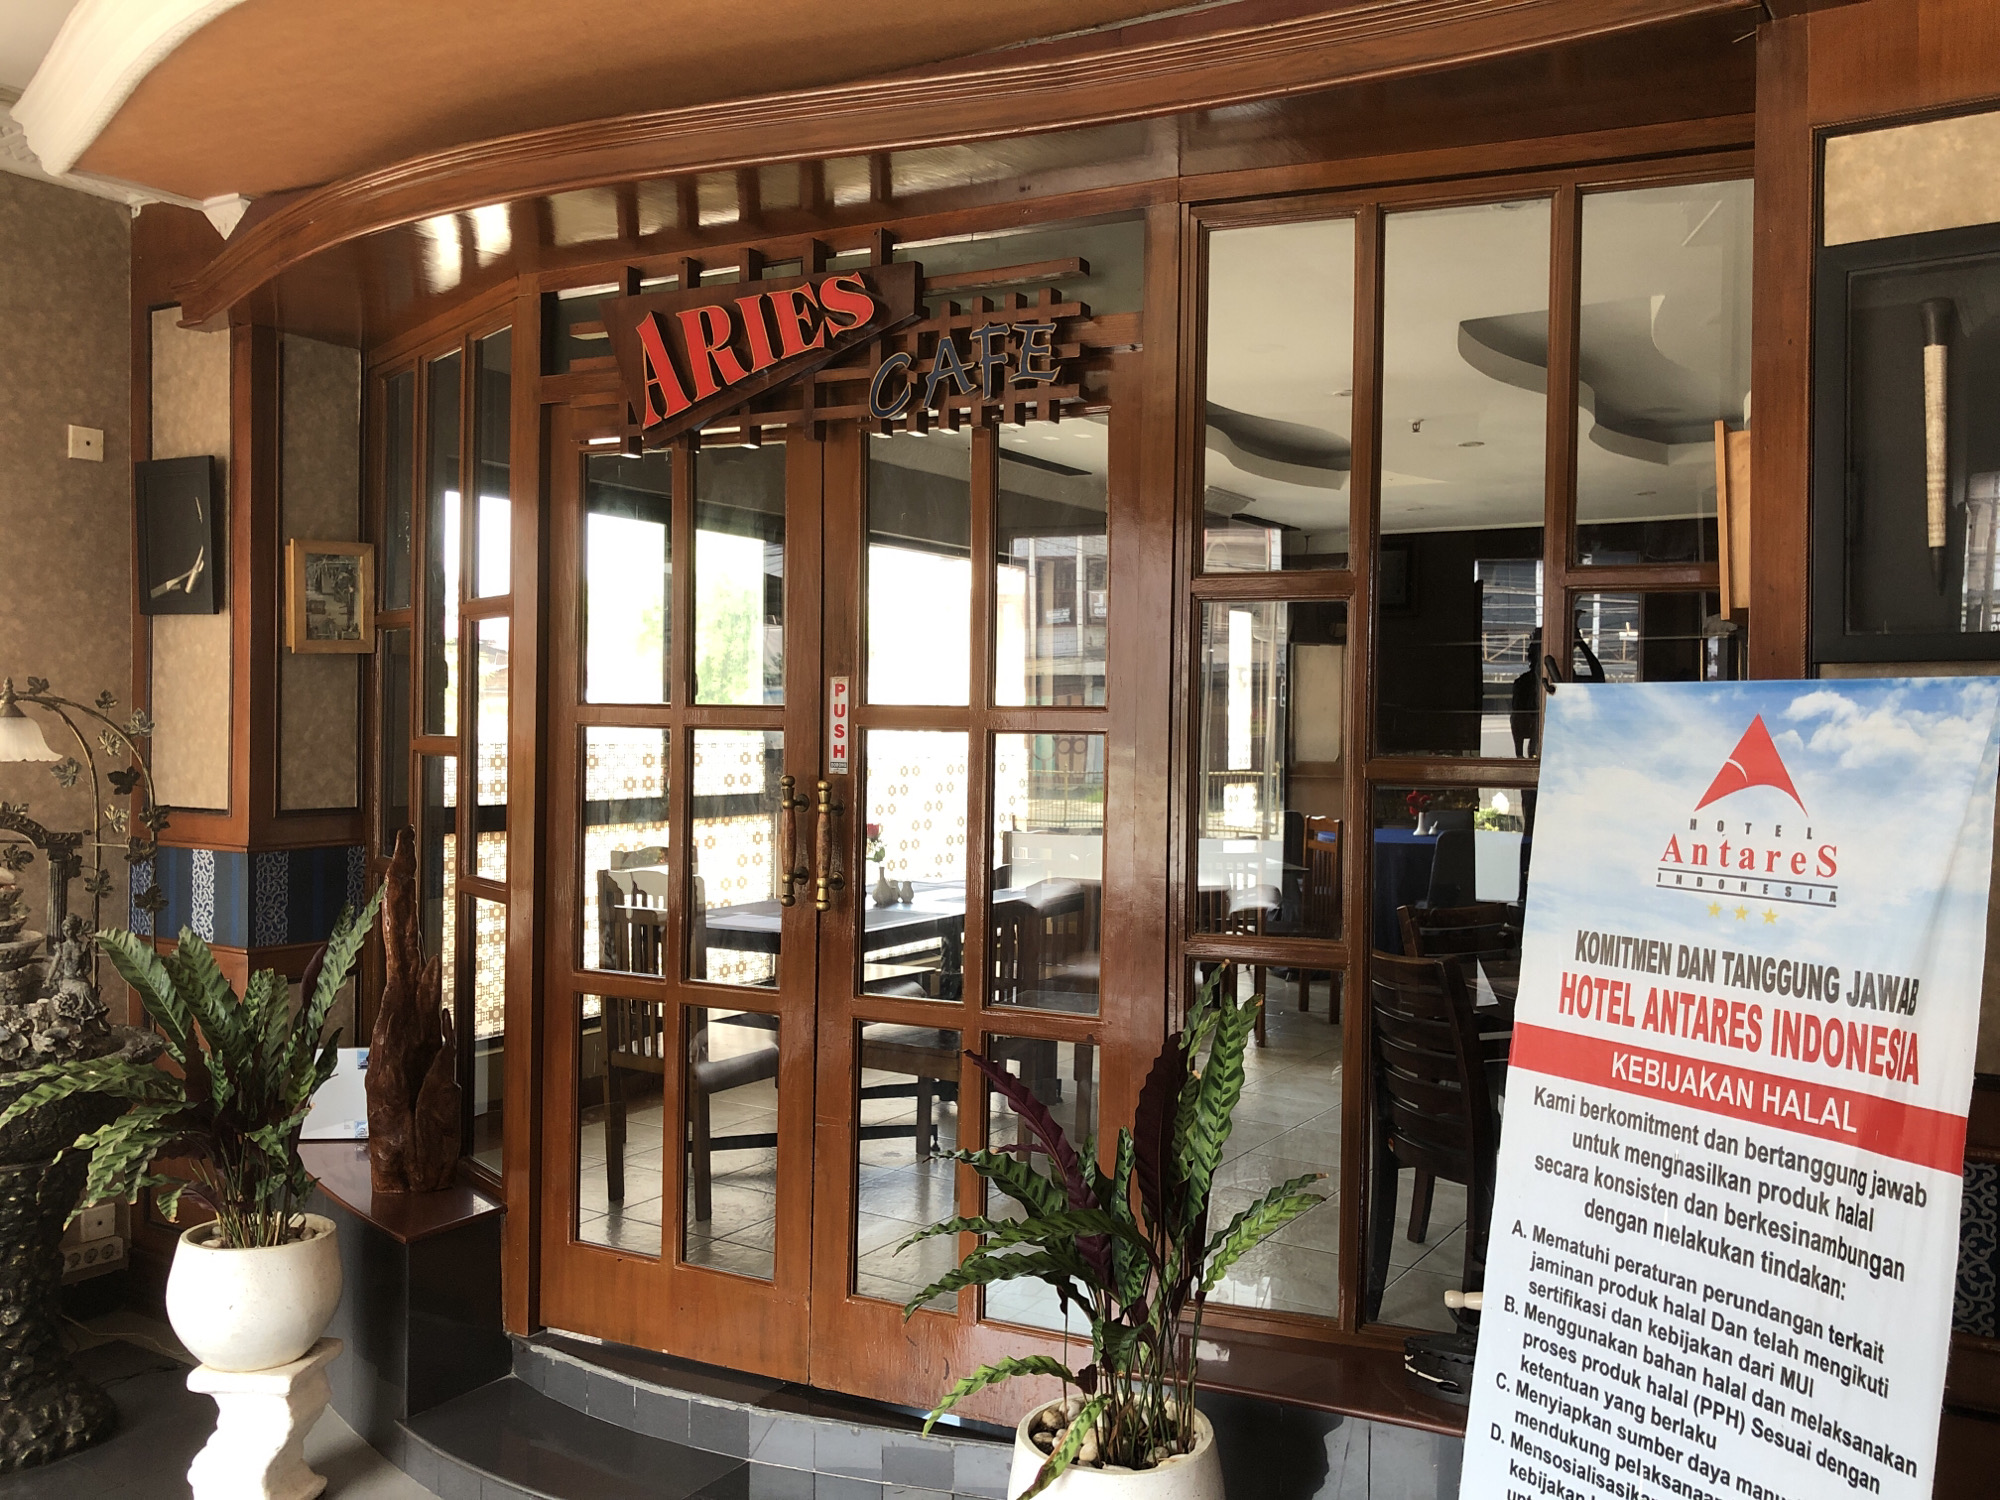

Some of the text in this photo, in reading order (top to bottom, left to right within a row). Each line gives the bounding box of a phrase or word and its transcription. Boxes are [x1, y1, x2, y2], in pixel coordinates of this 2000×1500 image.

[635, 271, 875, 429] ARIES
[869, 322, 1062, 419] CAFE
[833, 683, 846, 758] PUSH
[1660, 833, 1838, 878] AntareS
[1690, 818, 1812, 840] HOTEL
[1657, 872, 1836, 903] INDONESIA
[1575, 930, 1920, 1016] KOMITMEN DAN TANGGUNG JAWAB
[1558, 972, 1919, 1085] HOTEL ANTARES INDONESIA
[1612, 1052, 1857, 1133] KEBIJAKAN HALAL
[1534, 1086, 1927, 1208] Kami berkomitment dan bertanggung jawab
[1573, 1132, 1874, 1232] untuk menghasilkan produk halal
[1535, 1155, 1904, 1282] secara konsisten dan berkesinambungan
[1584, 1198, 1846, 1300] dengan melakukan tindakan:
[1512, 1220, 1884, 1364] A. Mematuhi peraturan perundangan terkait
[1529, 1281, 1814, 1398] sertifikasi dan kebijakan dari MUI
[1530, 1251, 1889, 1399] jaminan produk halal Dan telah mengikuti
[1491, 1422, 1504, 1444] D.
[1496, 1372, 1510, 1392] C.
[1516, 1379, 1611, 1435] Menyiapkan
[1617, 1426, 1683, 1464] sumber
[1688, 1454, 1730, 1486] daya
[1504, 1295, 1917, 1478] B. Menggunakan bahan halal dan melaksanakan
[1521, 1354, 1716, 1450] ketentuan yang berlaku
[1523, 1333, 1880, 1495] proses produk halal (PPH) Sesuai dengan
[1515, 1411, 1610, 1466] mendukung
